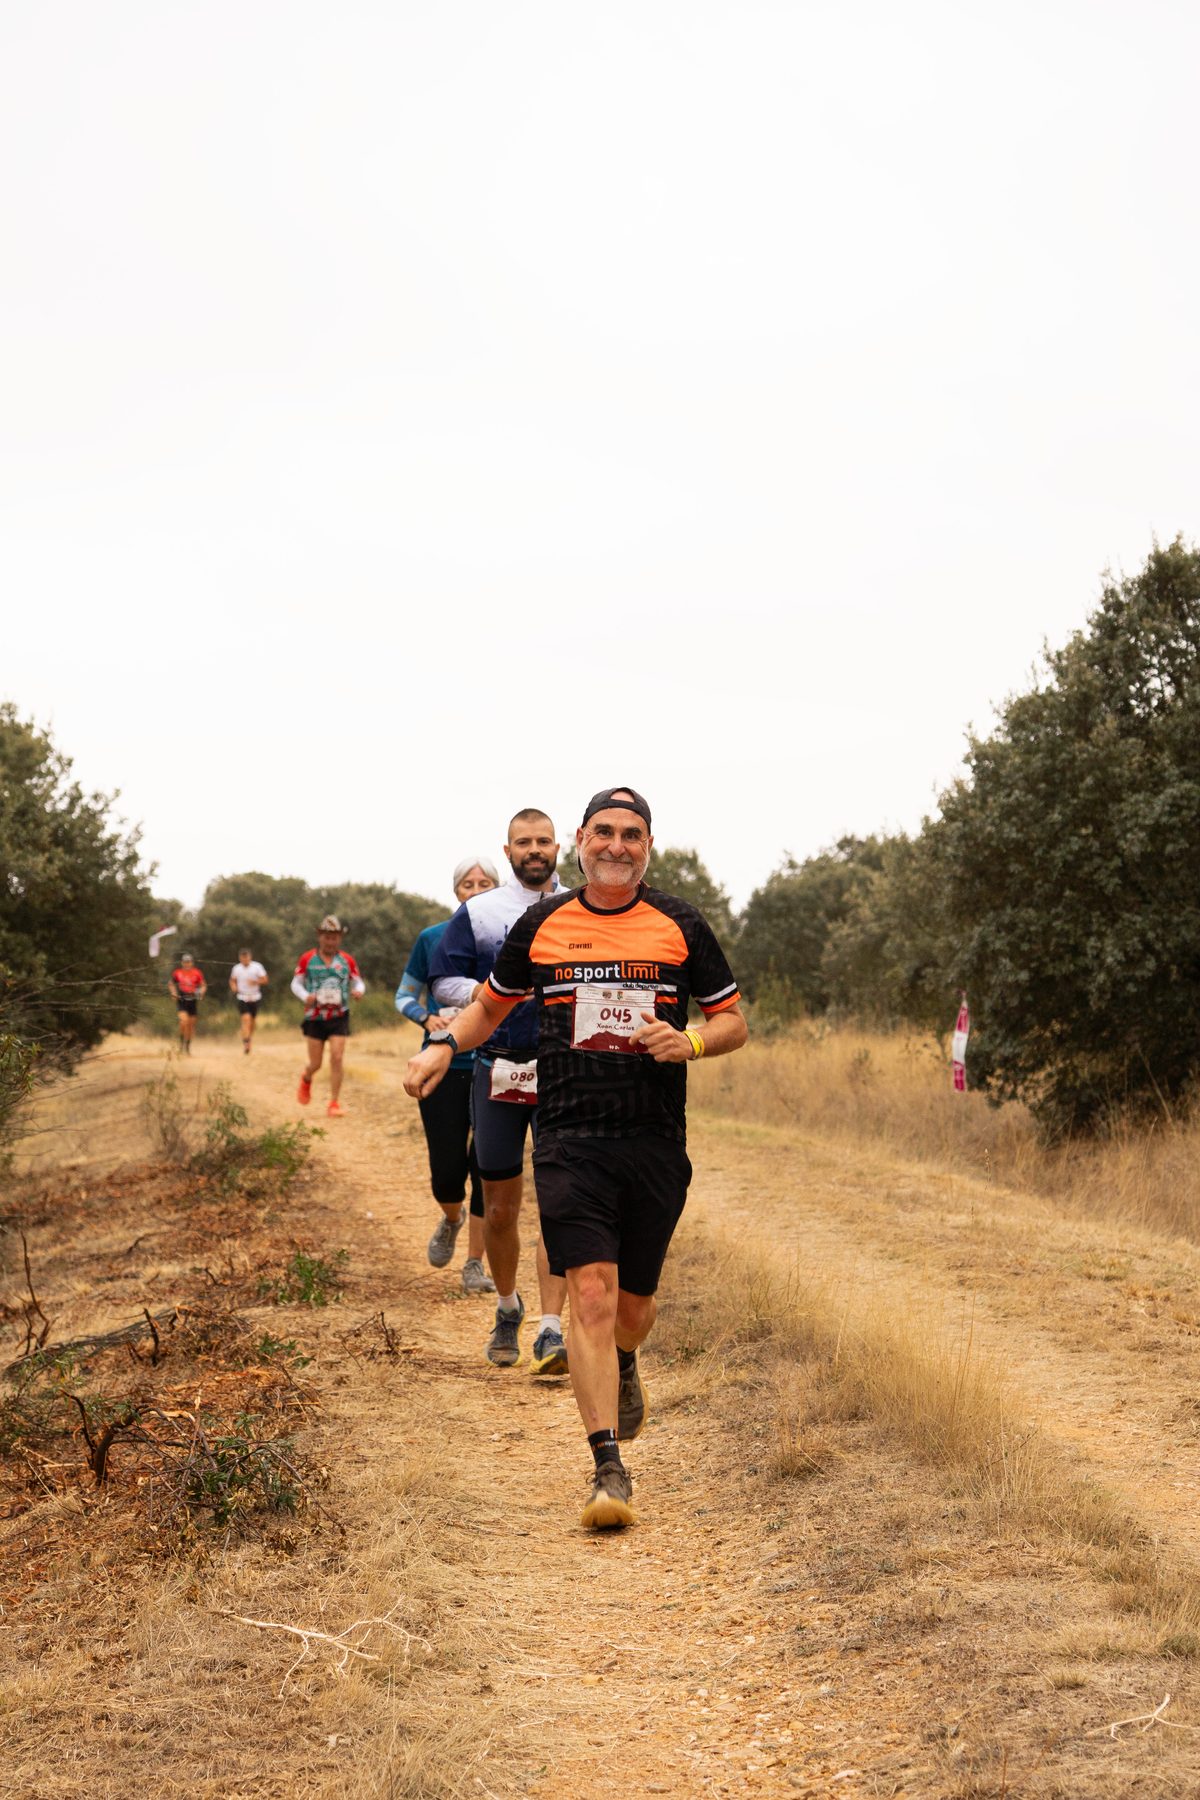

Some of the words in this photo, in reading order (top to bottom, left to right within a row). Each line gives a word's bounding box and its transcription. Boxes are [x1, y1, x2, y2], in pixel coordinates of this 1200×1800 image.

[555, 961, 660, 982] nosportlimit
[600, 1007, 632, 1023] 045
[510, 1072, 534, 1082] 080
